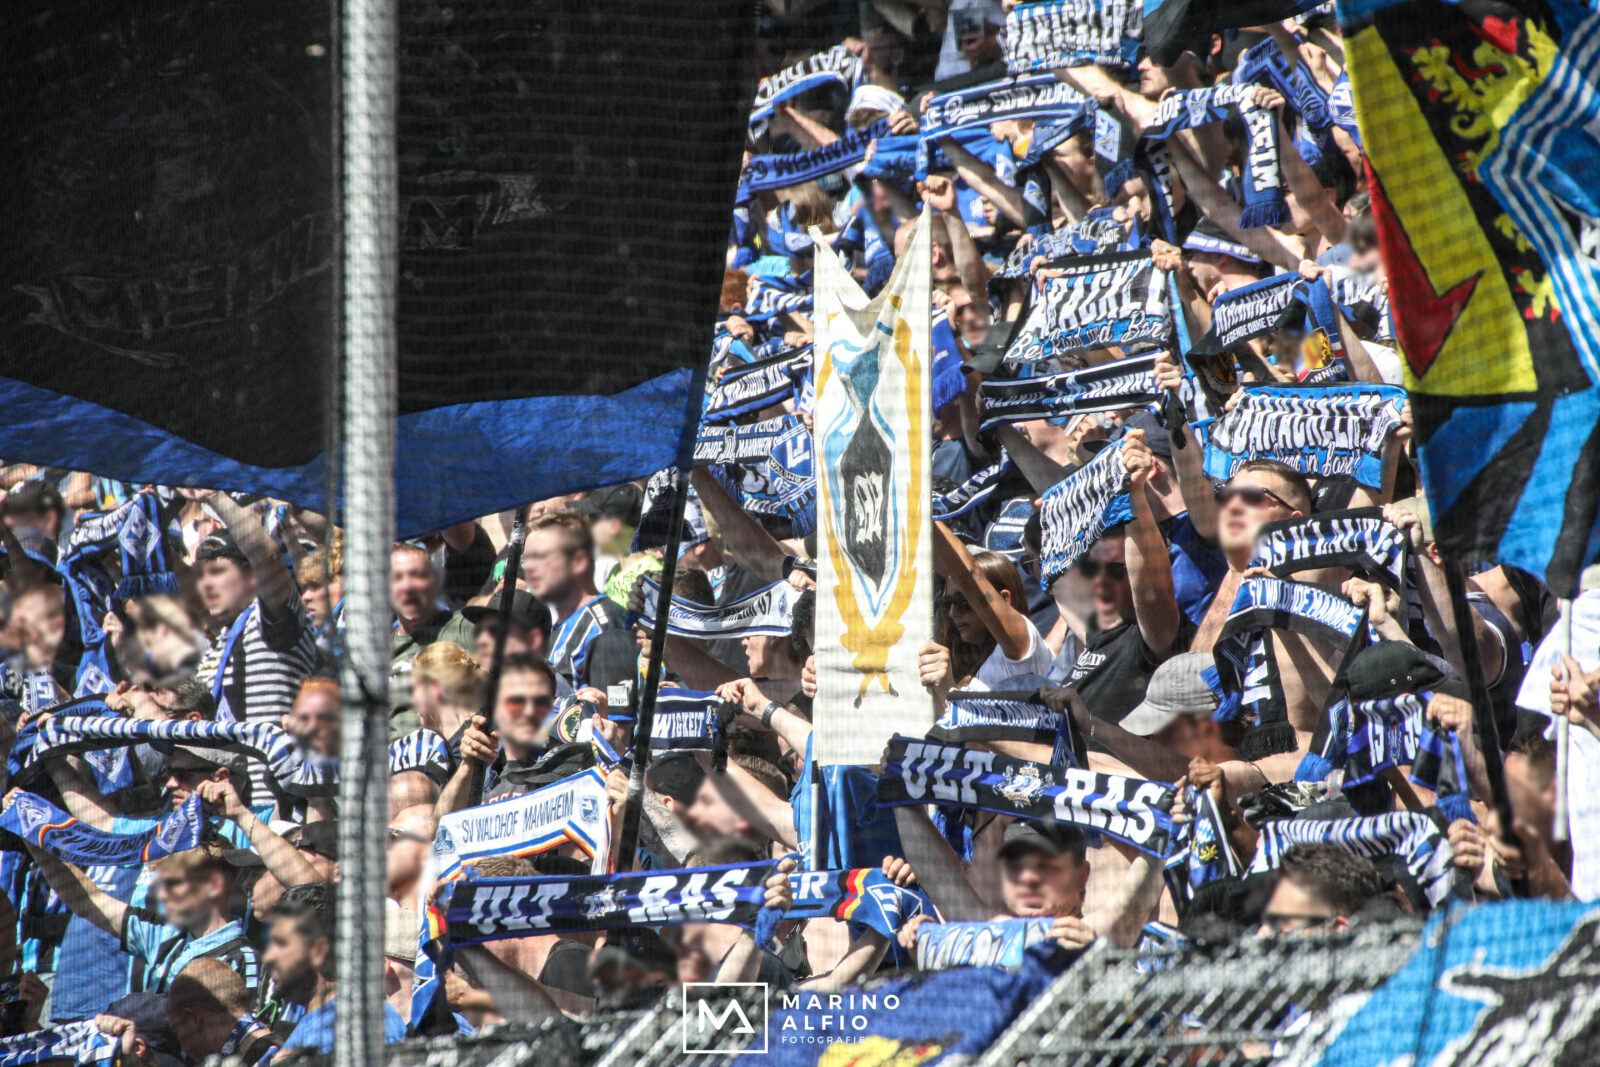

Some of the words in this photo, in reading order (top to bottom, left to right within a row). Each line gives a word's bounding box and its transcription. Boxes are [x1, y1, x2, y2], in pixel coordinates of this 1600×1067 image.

[1153, 93, 1184, 126] HOF
[770, 459, 801, 484] WALDHO
[1308, 588, 1365, 638] MANNHE
[650, 711, 705, 739] WIGKEIT
[461, 818, 475, 844] SV
[475, 810, 519, 842] WALDHOF
[522, 789, 574, 833] MANNHEIM
[790, 871, 829, 900] ER
